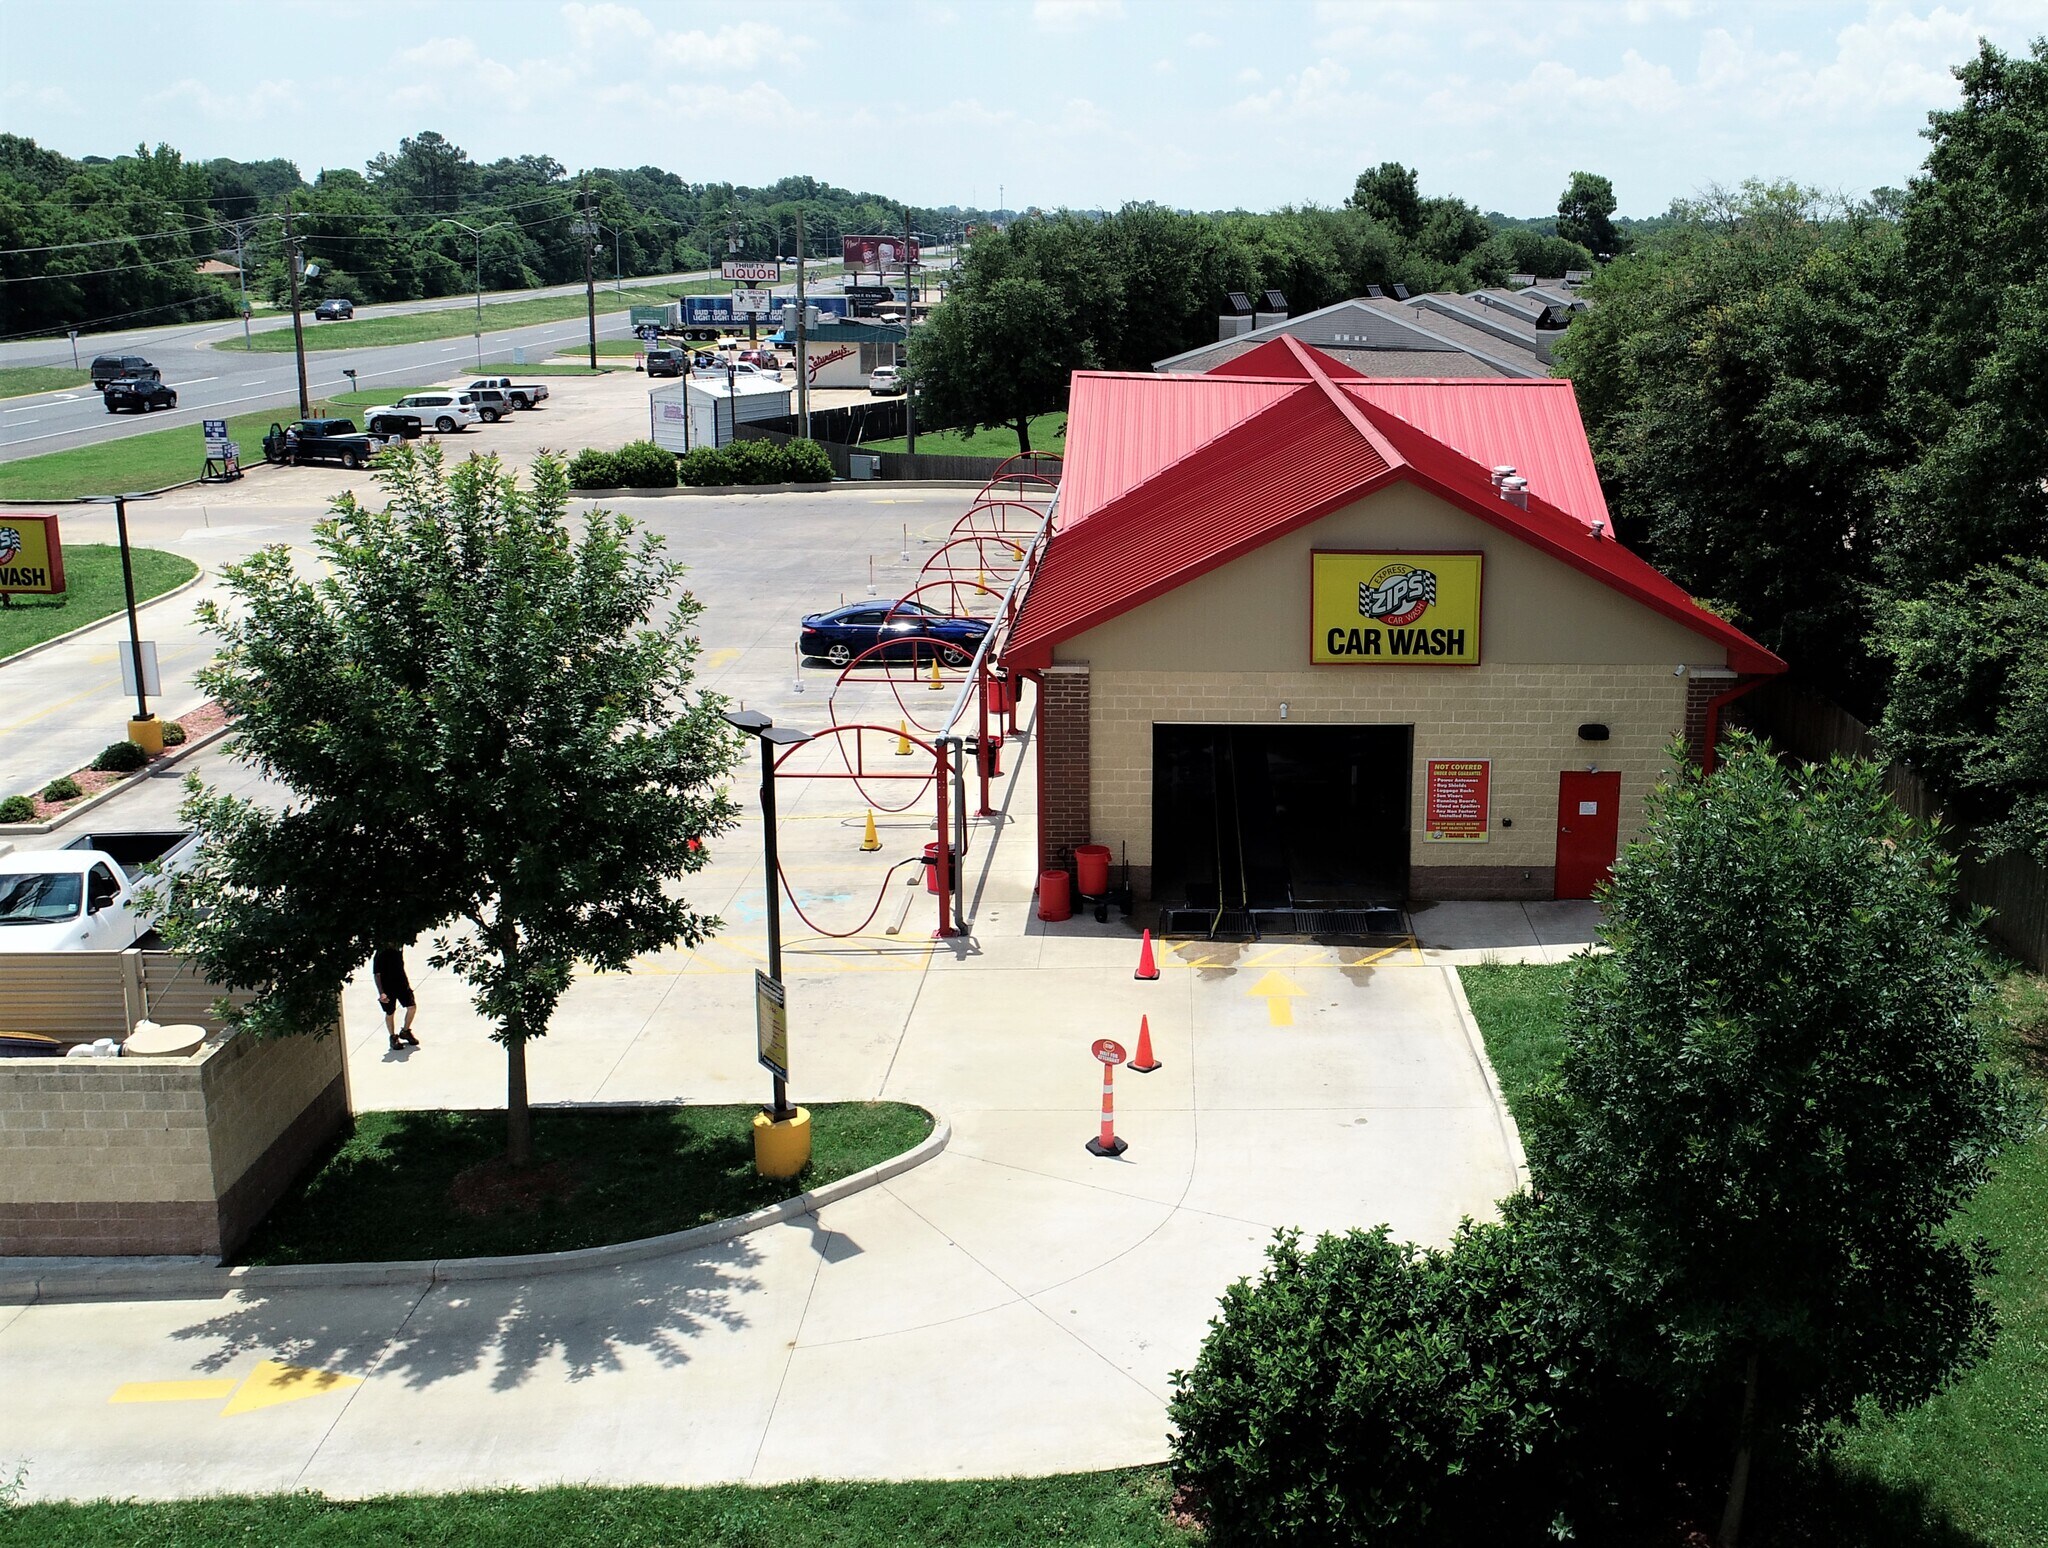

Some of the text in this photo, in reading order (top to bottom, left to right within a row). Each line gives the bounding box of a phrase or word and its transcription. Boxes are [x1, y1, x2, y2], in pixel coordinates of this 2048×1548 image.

[724, 269, 776, 279] LIQUOR
[1374, 566, 1407, 584] EXPRESS
[1372, 574, 1424, 614] ZIPS
[1388, 602, 1425, 624] CAR WASH
[1327, 628, 1464, 656] CAR WASH
